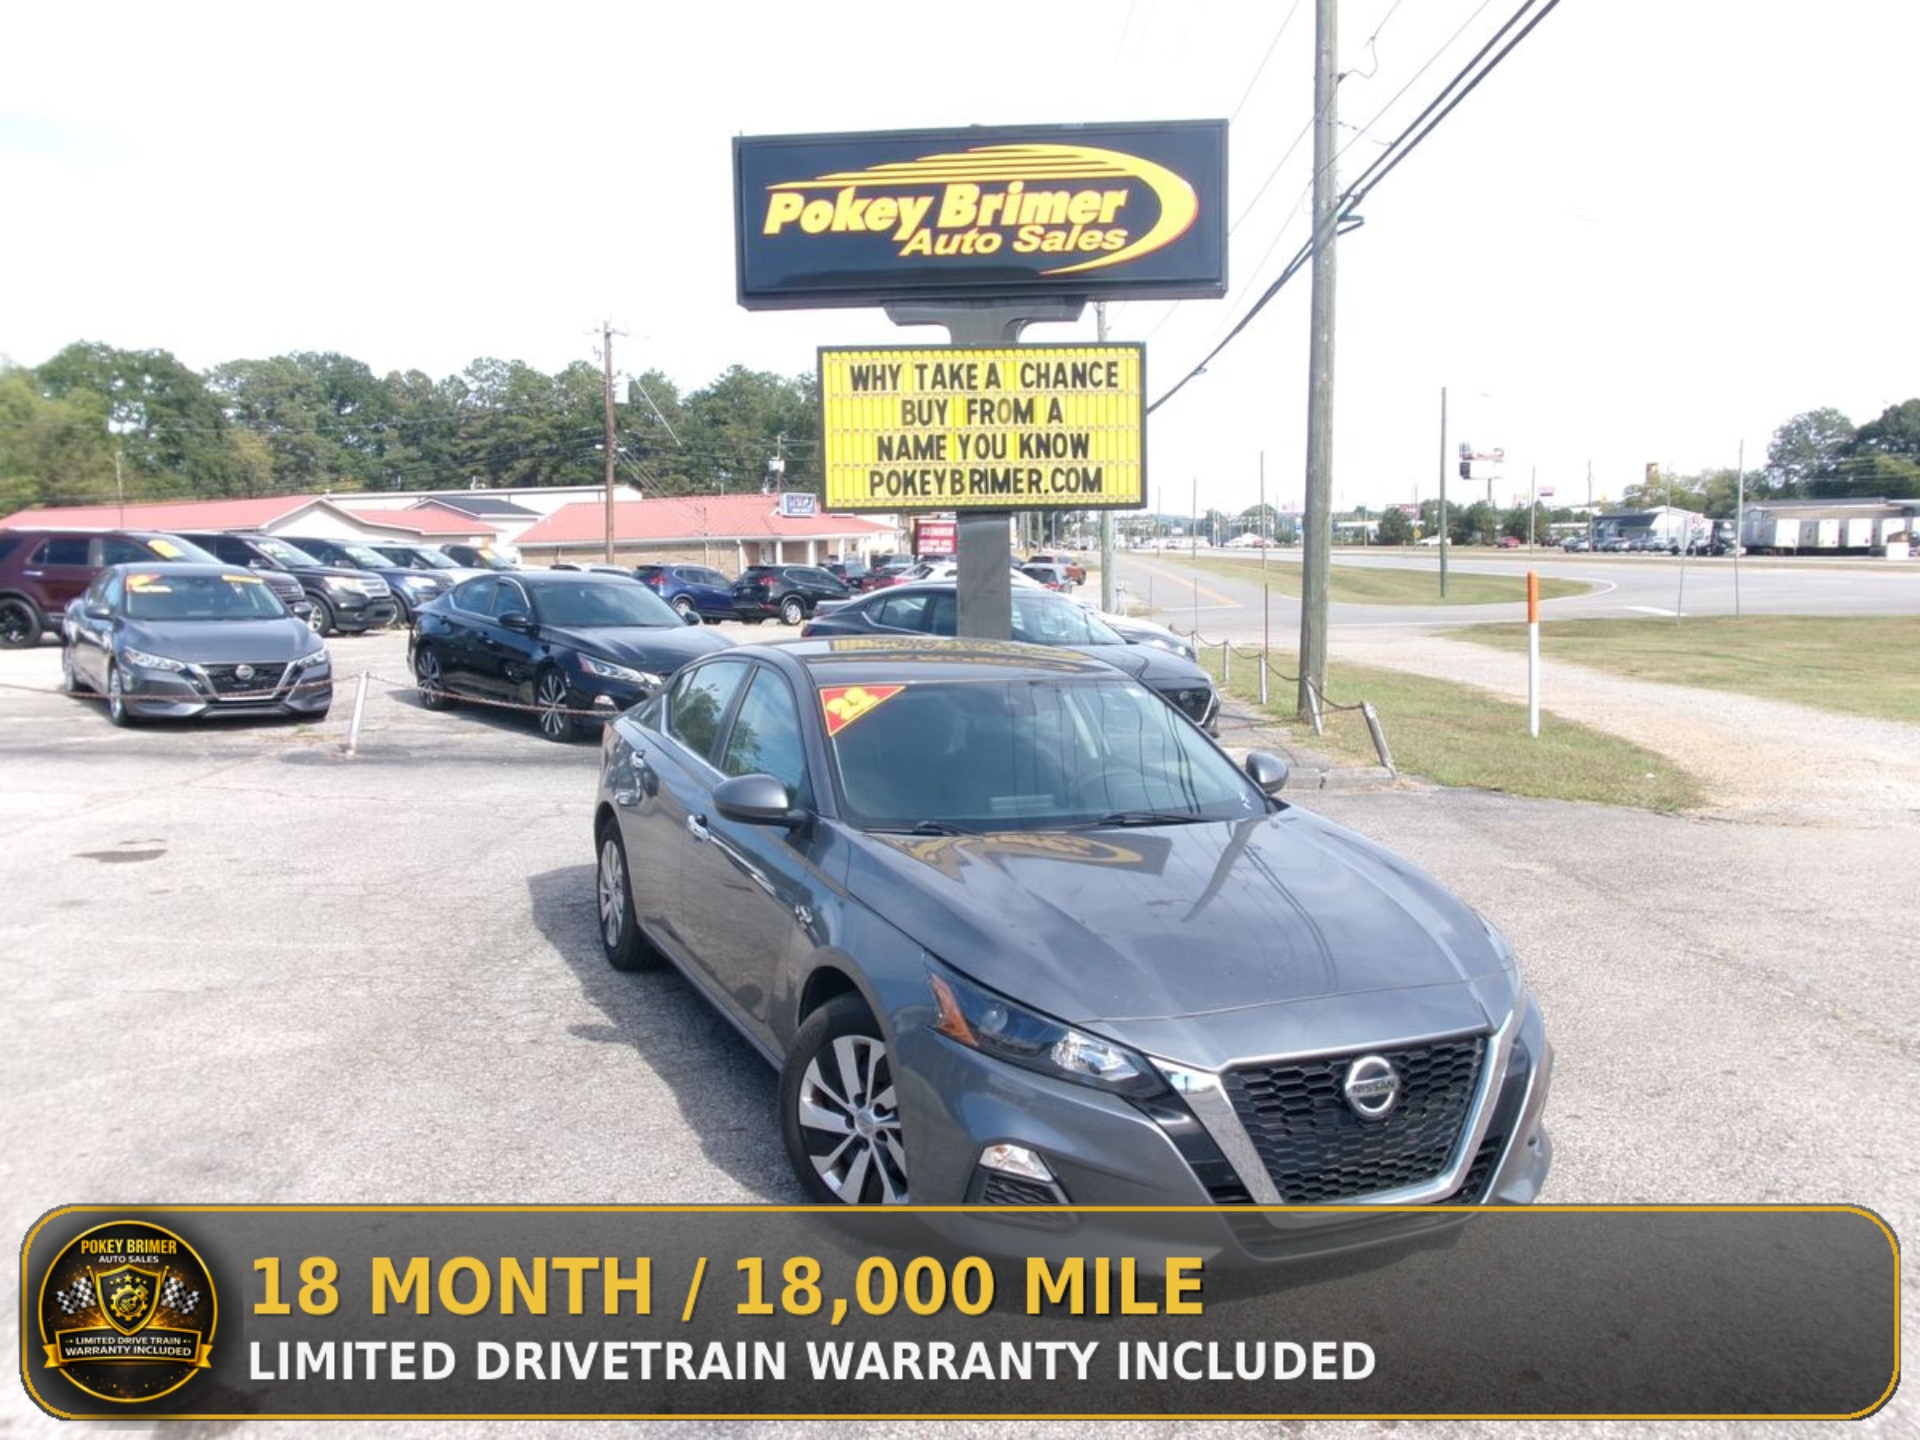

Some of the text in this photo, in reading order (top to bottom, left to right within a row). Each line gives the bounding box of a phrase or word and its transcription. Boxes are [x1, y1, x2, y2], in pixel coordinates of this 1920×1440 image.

[763, 181, 1128, 241] Pokey Brimer
[899, 224, 1128, 256] Auto Sales
[850, 361, 1119, 391] WHY TAKE A CHANCE
[901, 397, 1063, 426] BUY FROM A
[877, 432, 1090, 462] NAME YOU KNOW
[869, 467, 1103, 497] POKEYBRIMER.COM
[1351, 1079, 1395, 1094] NISSAN
